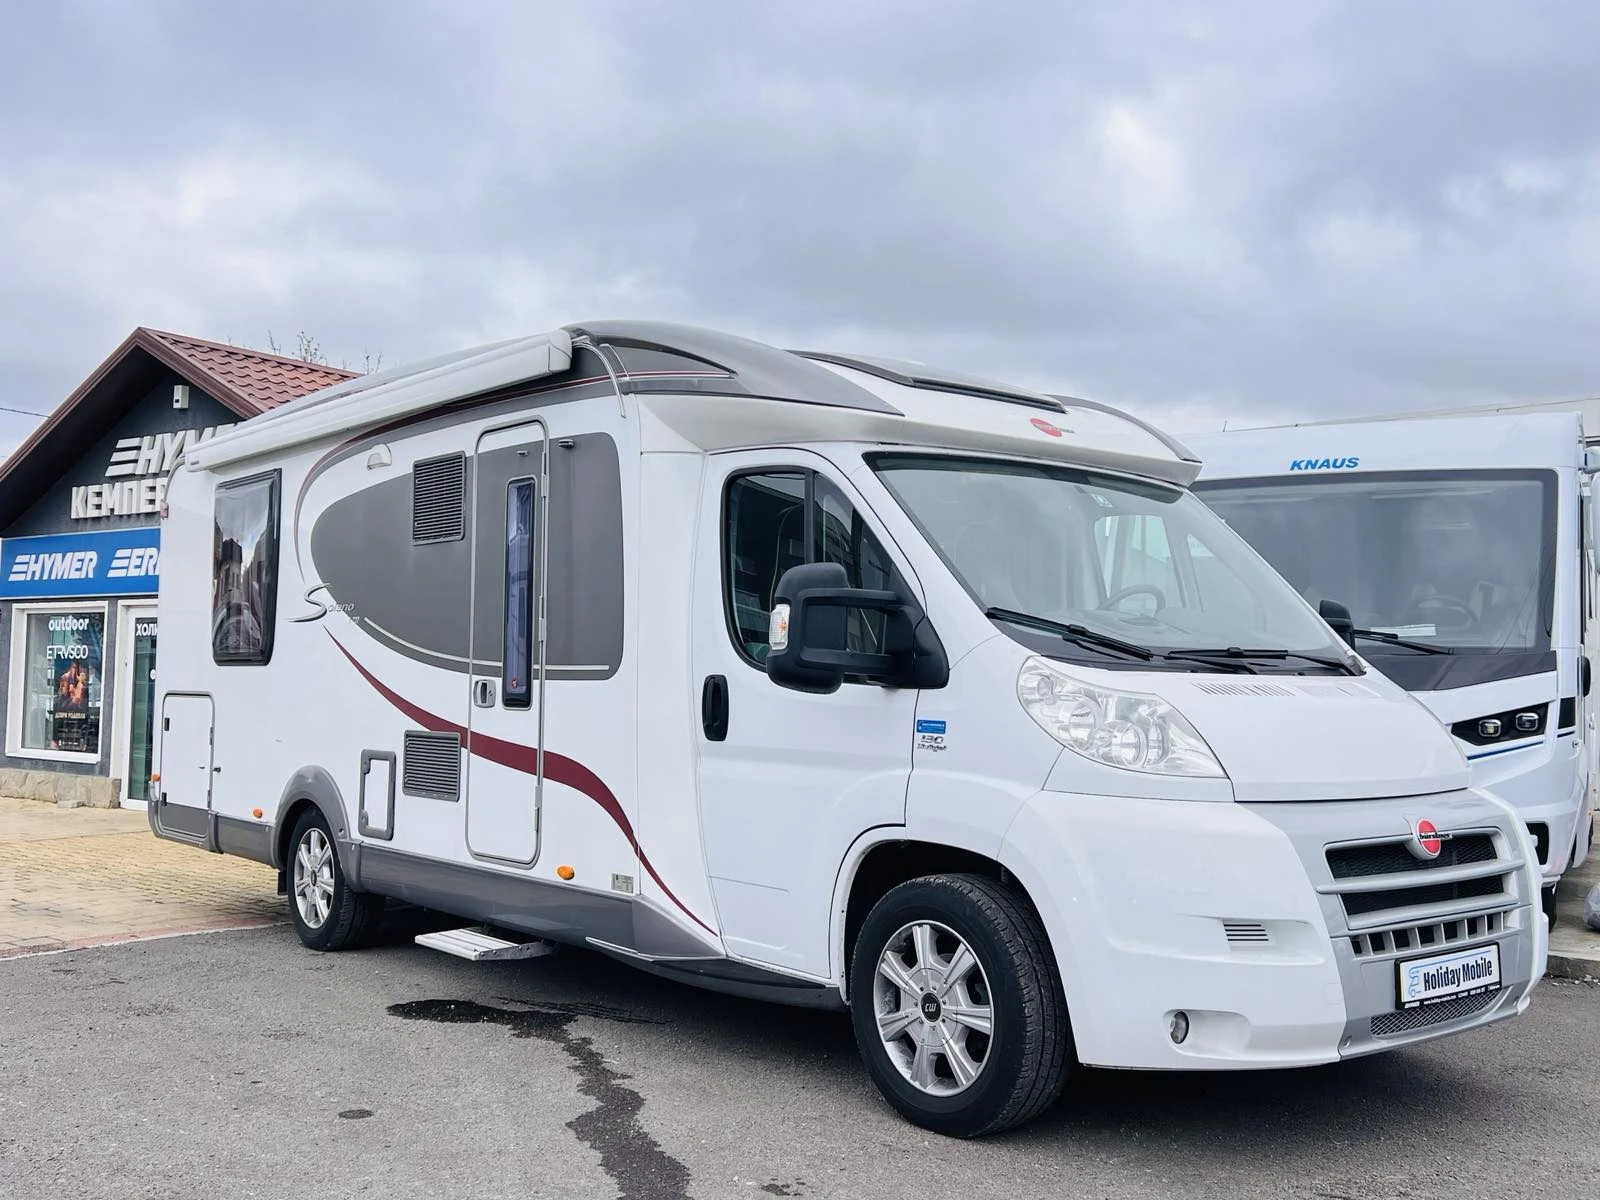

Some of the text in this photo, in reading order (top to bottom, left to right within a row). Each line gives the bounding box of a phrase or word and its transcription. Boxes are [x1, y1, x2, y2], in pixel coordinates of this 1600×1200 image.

[1289, 457, 1360, 471] KNAUS
[25, 550, 98, 581] HYMER
[48, 615, 90, 632] outdoor
[1423, 957, 1493, 991] Holiday Mobile
